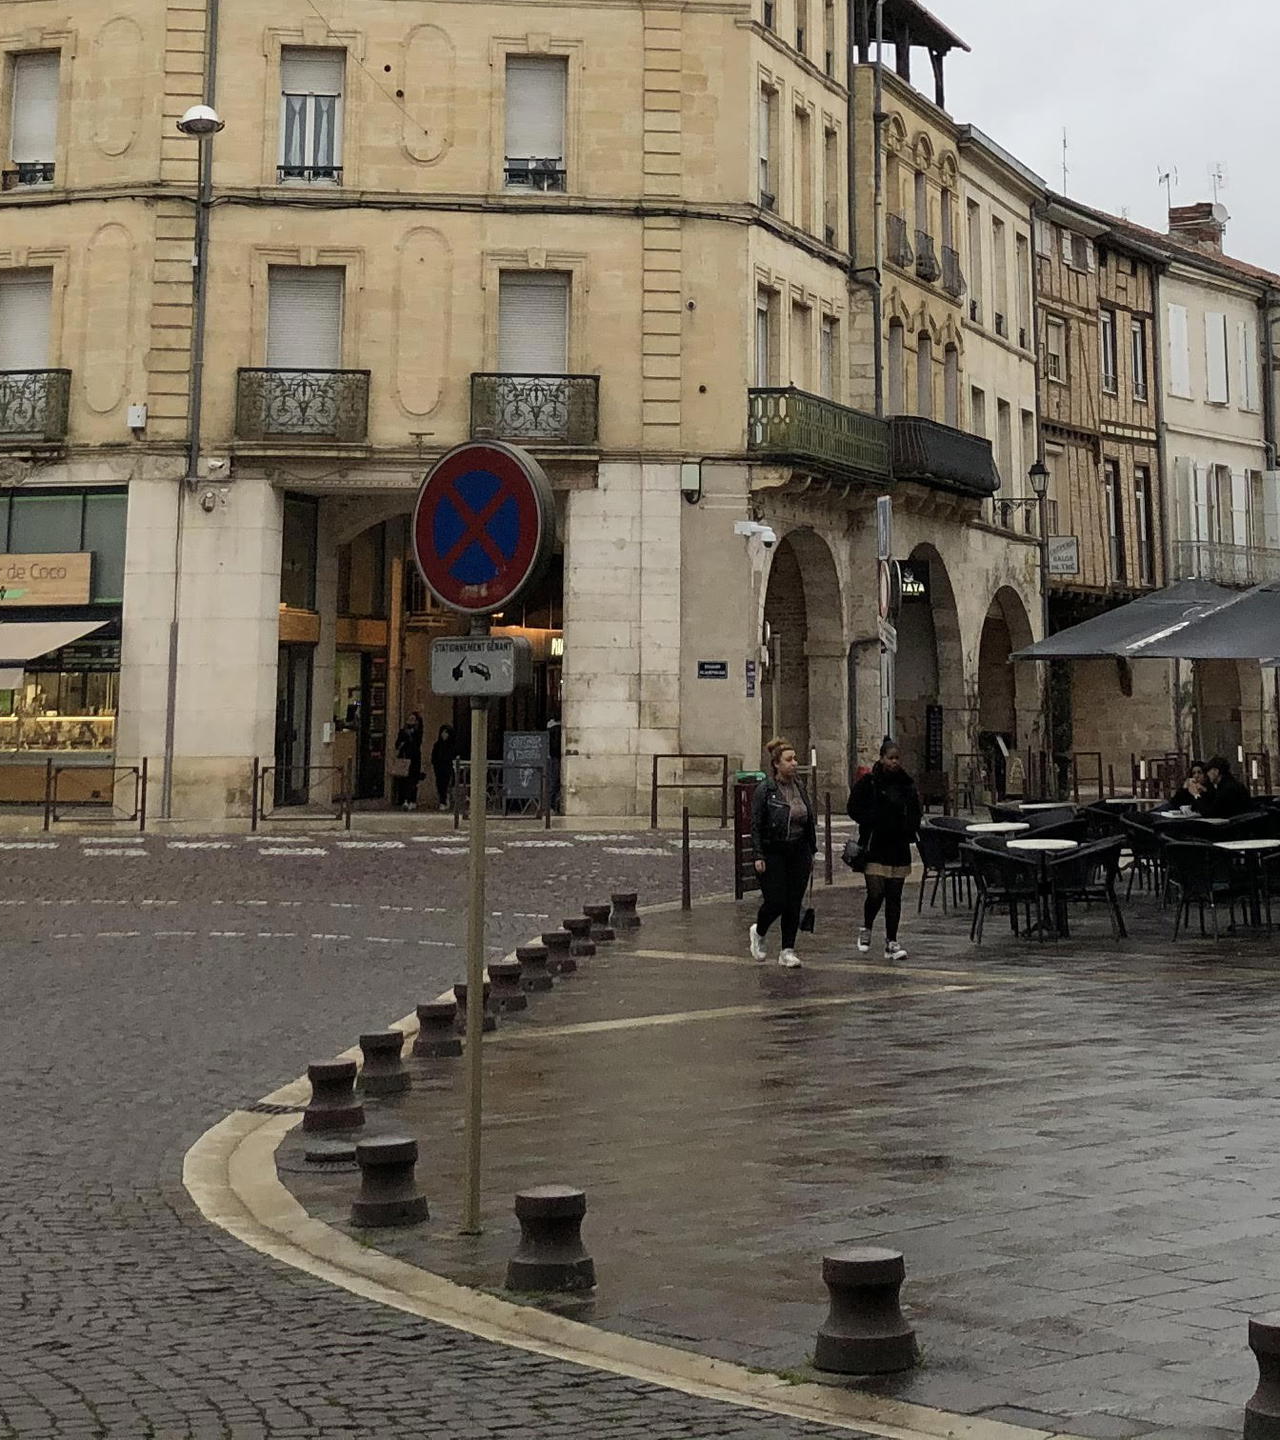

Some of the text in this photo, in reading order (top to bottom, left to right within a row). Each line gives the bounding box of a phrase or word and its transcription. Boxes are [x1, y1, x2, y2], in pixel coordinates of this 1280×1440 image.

[7, 563, 26, 580] de
[30, 563, 67, 580] Coco
[434, 643, 485, 653] STATIONNEMENT
